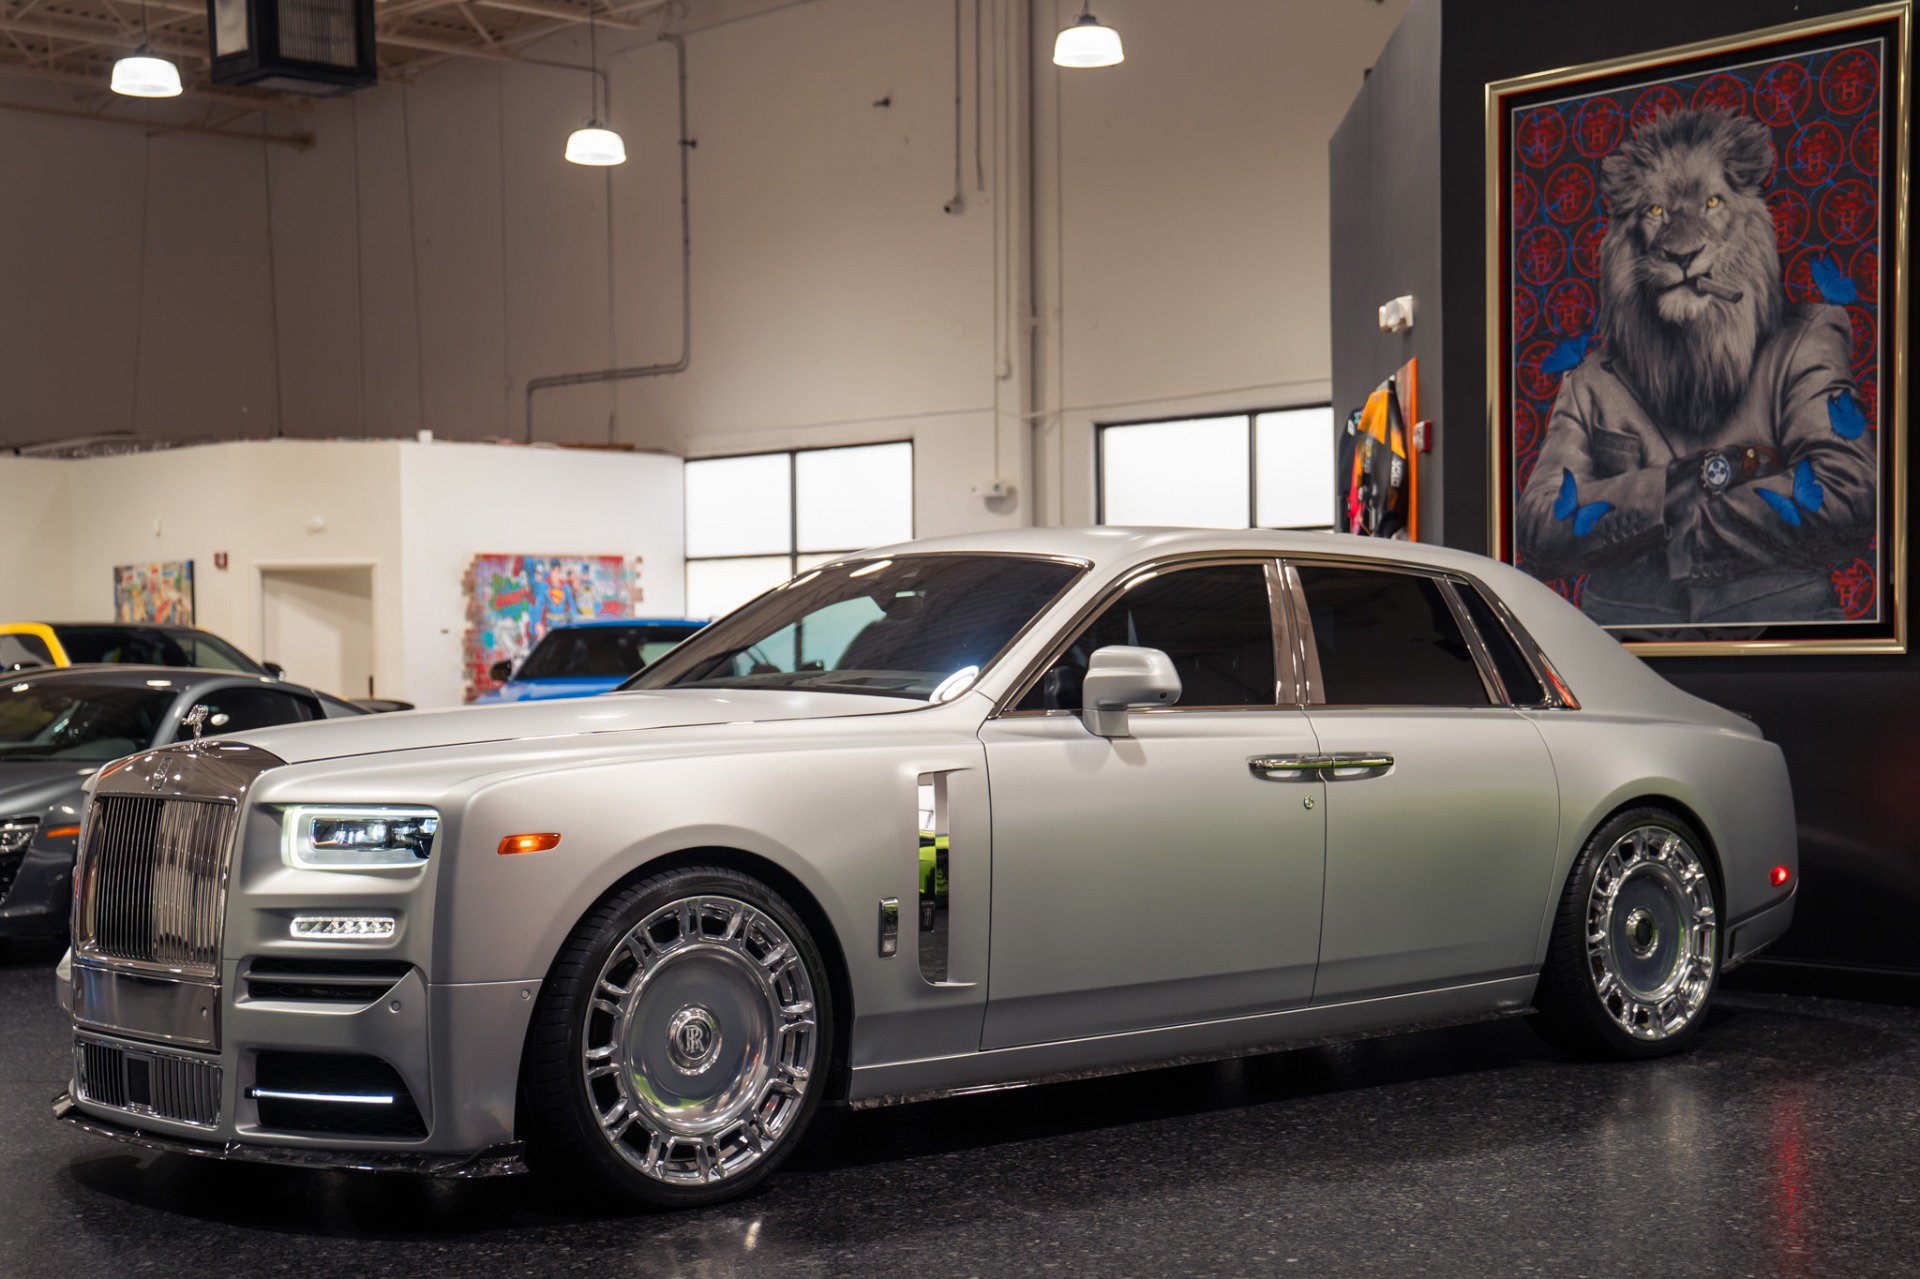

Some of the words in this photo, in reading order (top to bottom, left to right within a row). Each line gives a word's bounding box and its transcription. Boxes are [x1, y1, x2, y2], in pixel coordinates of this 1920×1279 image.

[1841, 82, 1857, 101] H
[1592, 127, 1606, 145] H
[1808, 152, 1823, 171] H
[1563, 192, 1576, 210] H
[1775, 220, 1789, 238] H
[1841, 211, 1856, 230] H
[1563, 306, 1576, 324] H
[1840, 587, 1855, 606] H
[684, 1024, 705, 1053] RR
